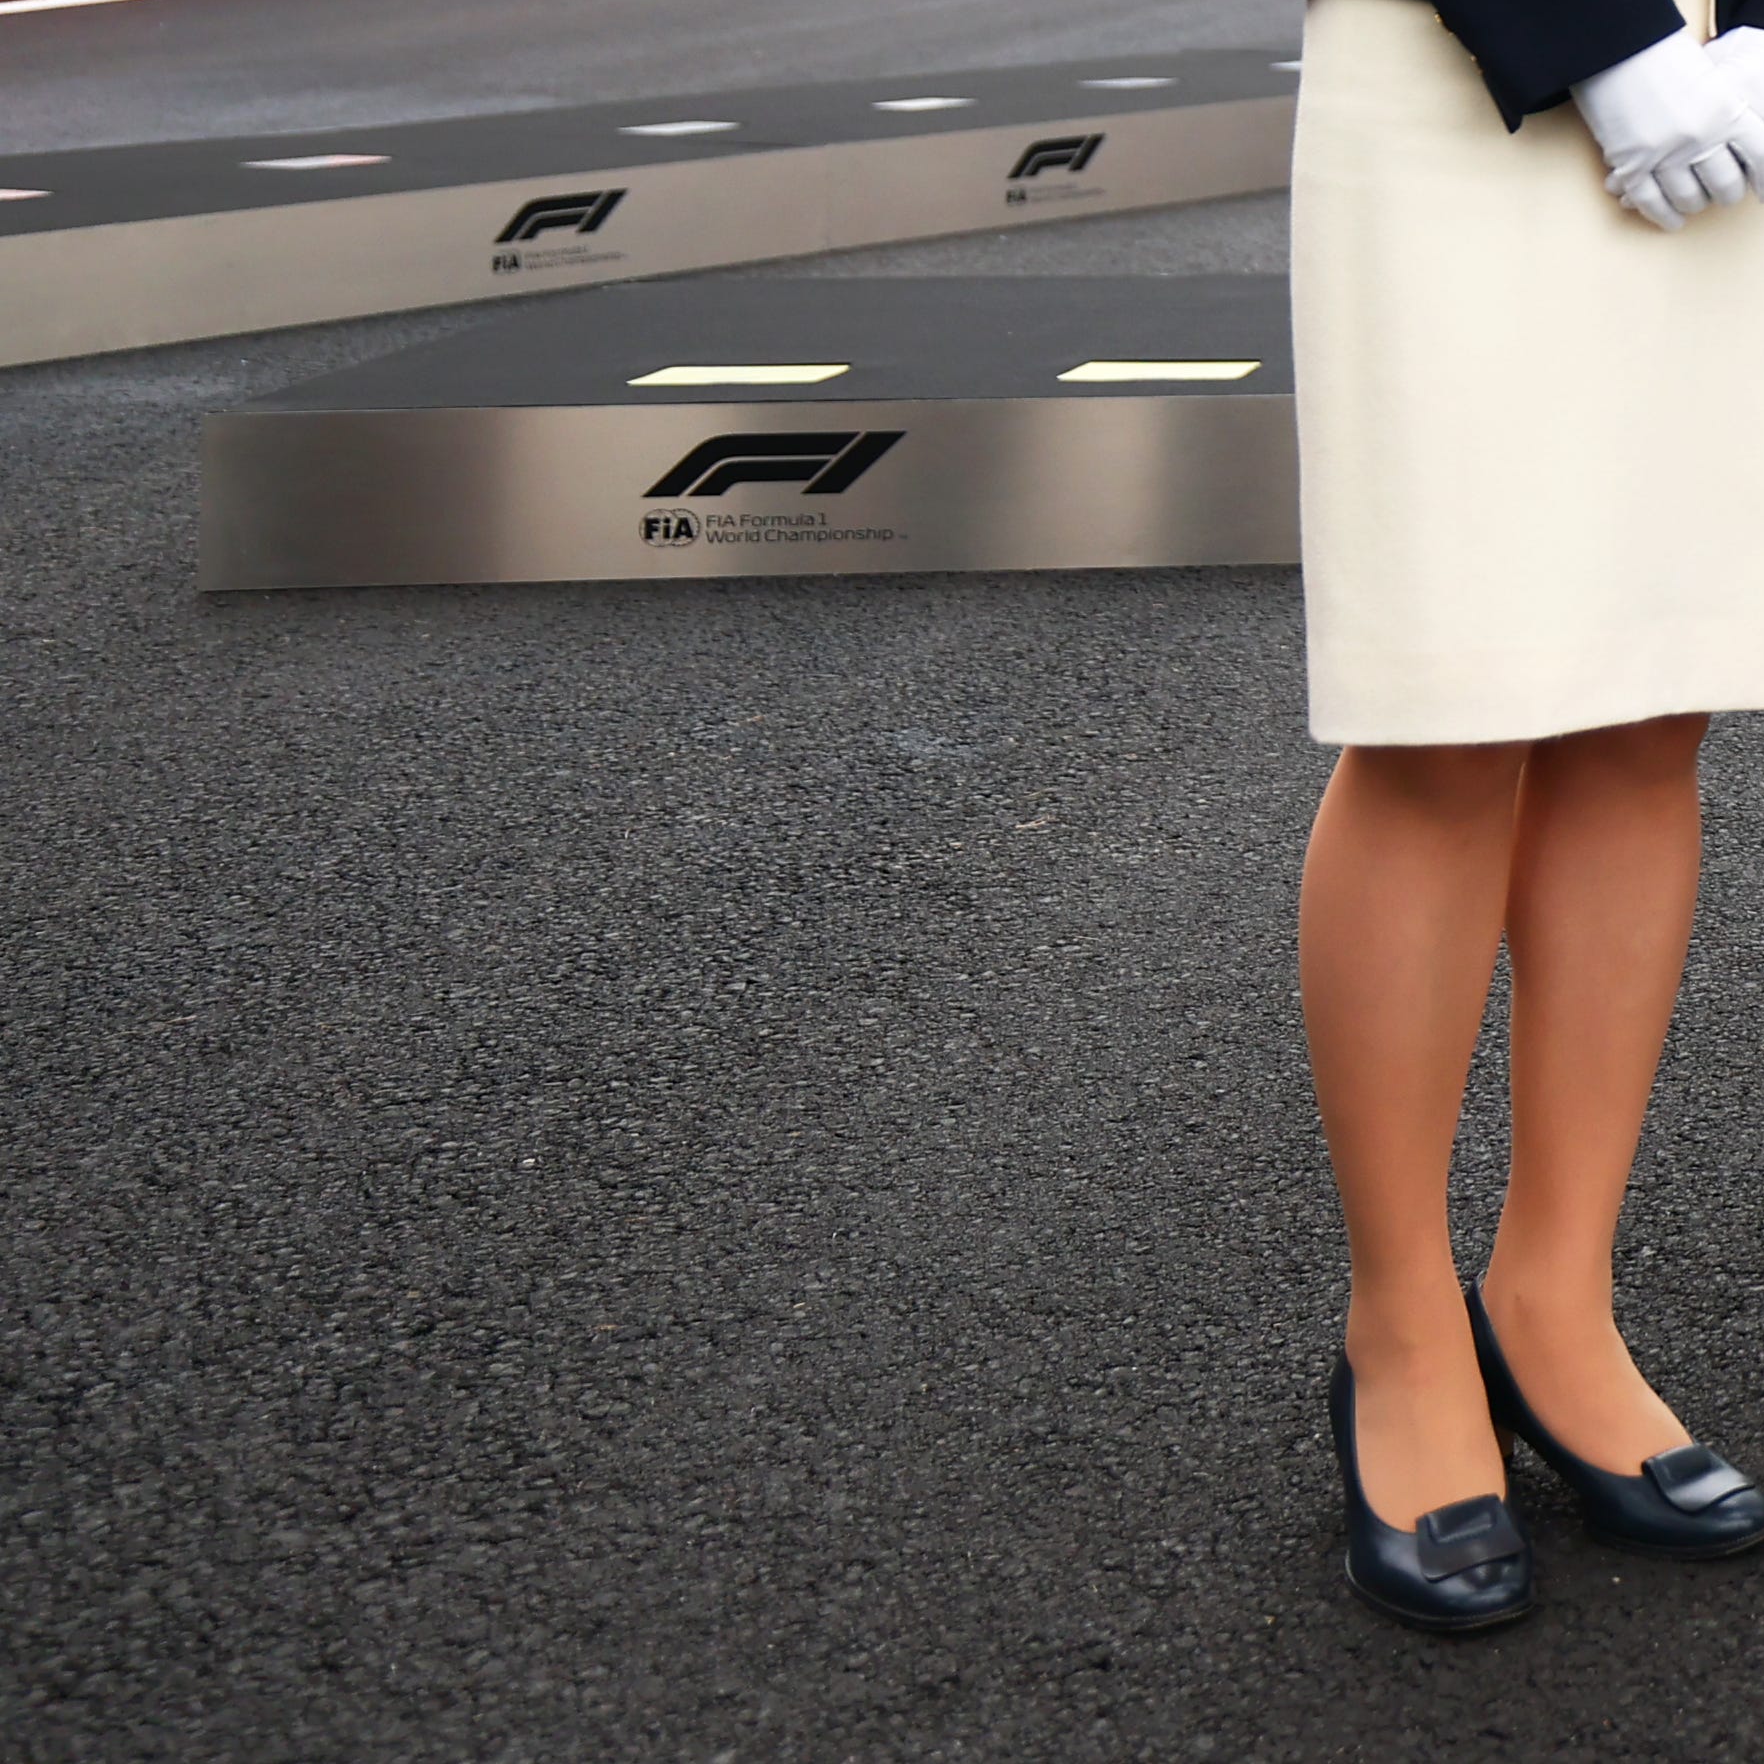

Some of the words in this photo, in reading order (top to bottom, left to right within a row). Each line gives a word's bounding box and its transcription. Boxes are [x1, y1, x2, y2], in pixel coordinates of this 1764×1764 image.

[706, 515, 736, 528] FIA
[740, 513, 815, 528] Formula
[818, 513, 827, 526] 1
[706, 529, 760, 544] World
[764, 527, 894, 543] Championship
